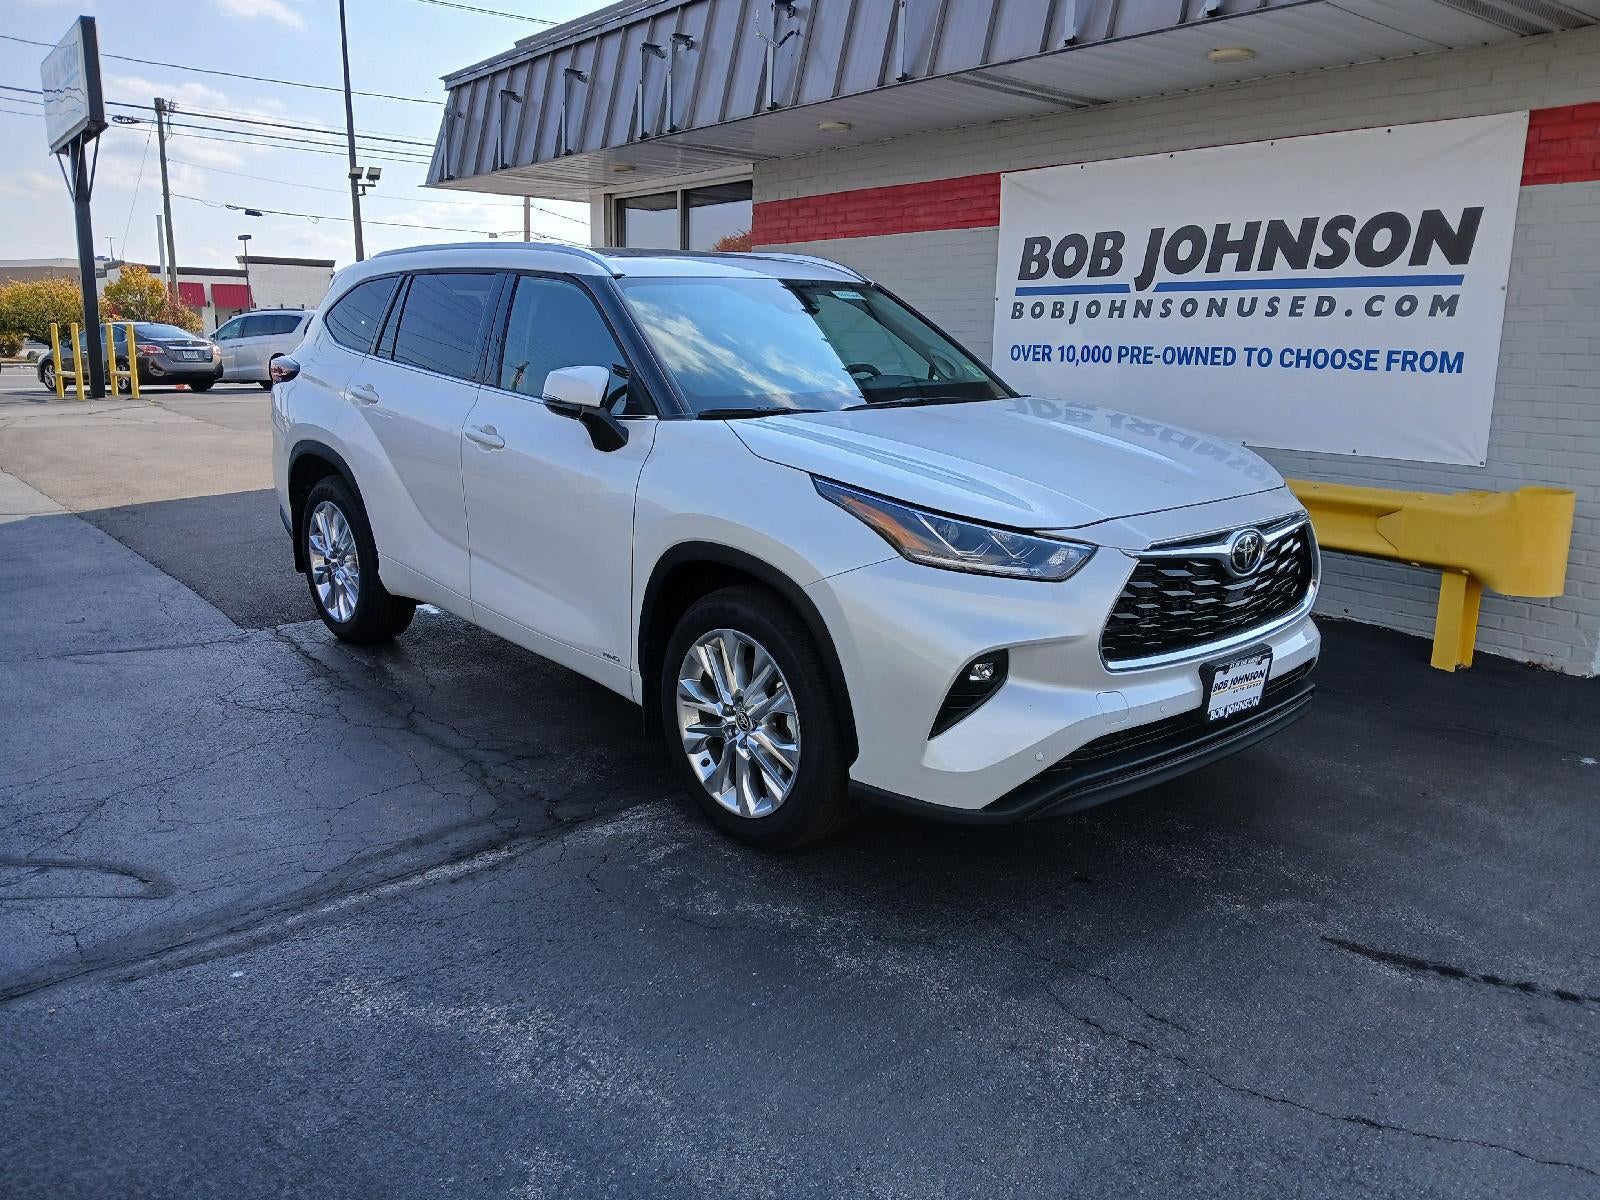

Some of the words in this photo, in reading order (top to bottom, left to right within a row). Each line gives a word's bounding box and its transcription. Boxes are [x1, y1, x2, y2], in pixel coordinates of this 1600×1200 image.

[1018, 230, 1126, 281] BOB
[1133, 207, 1484, 292] JOHNSON
[1010, 294, 1461, 325] BOBJOHNSONUSED.COM
[1010, 344, 1052, 363] OVER
[1057, 345, 1113, 366] 10,000
[1117, 345, 1237, 367] PRE-OWNED
[1244, 346, 1273, 367] TO
[1279, 348, 1379, 371] CHOOSE
[1385, 350, 1464, 373] FROM
[1213, 680, 1229, 692] BOB
[1229, 669, 1265, 689] JOHNSON
[1210, 706, 1225, 720] BOB
[1225, 696, 1260, 718] JOHNSON
